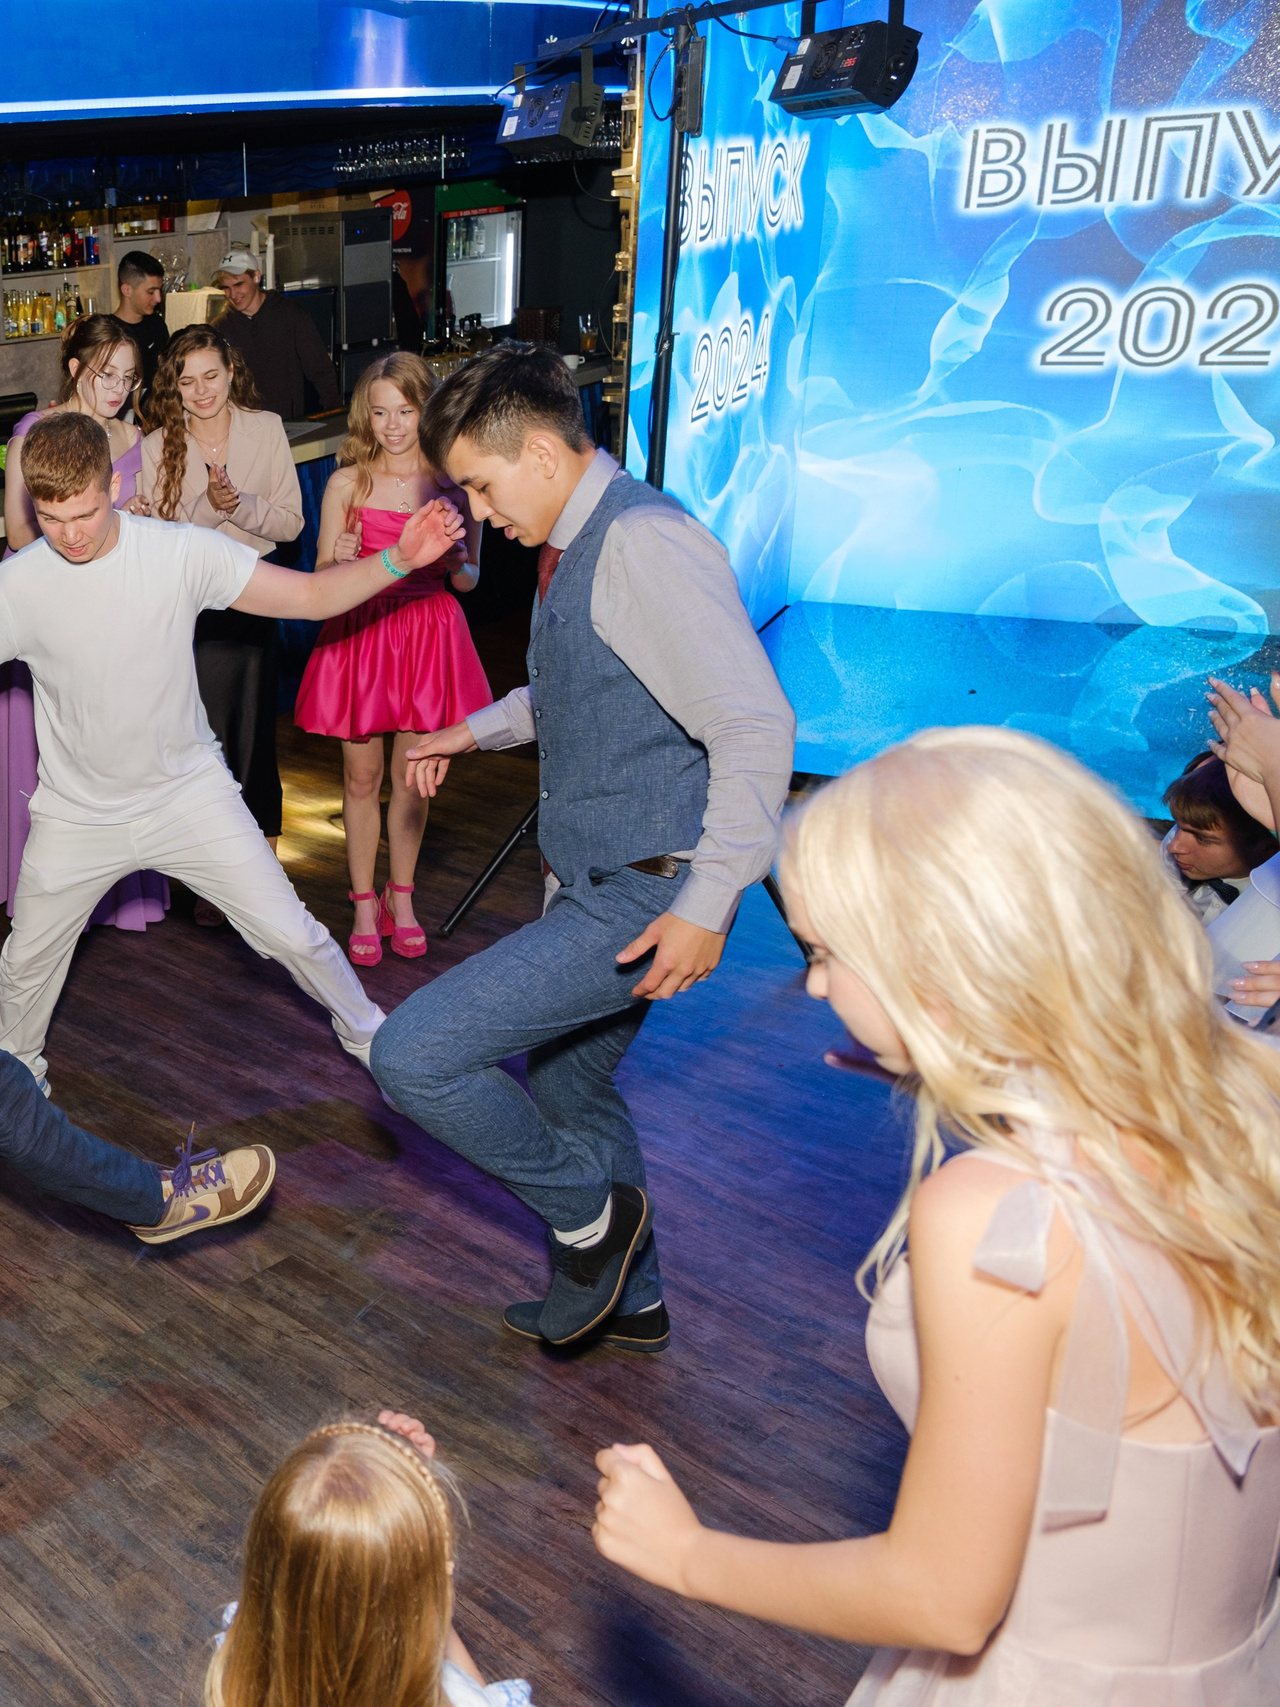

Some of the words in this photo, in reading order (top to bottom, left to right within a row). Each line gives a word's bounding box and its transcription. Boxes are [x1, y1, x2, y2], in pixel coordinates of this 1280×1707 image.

[680, 141, 809, 247] ВЫПУСК
[691, 313, 769, 423] 2024
[1040, 283, 1280, 367] 202
